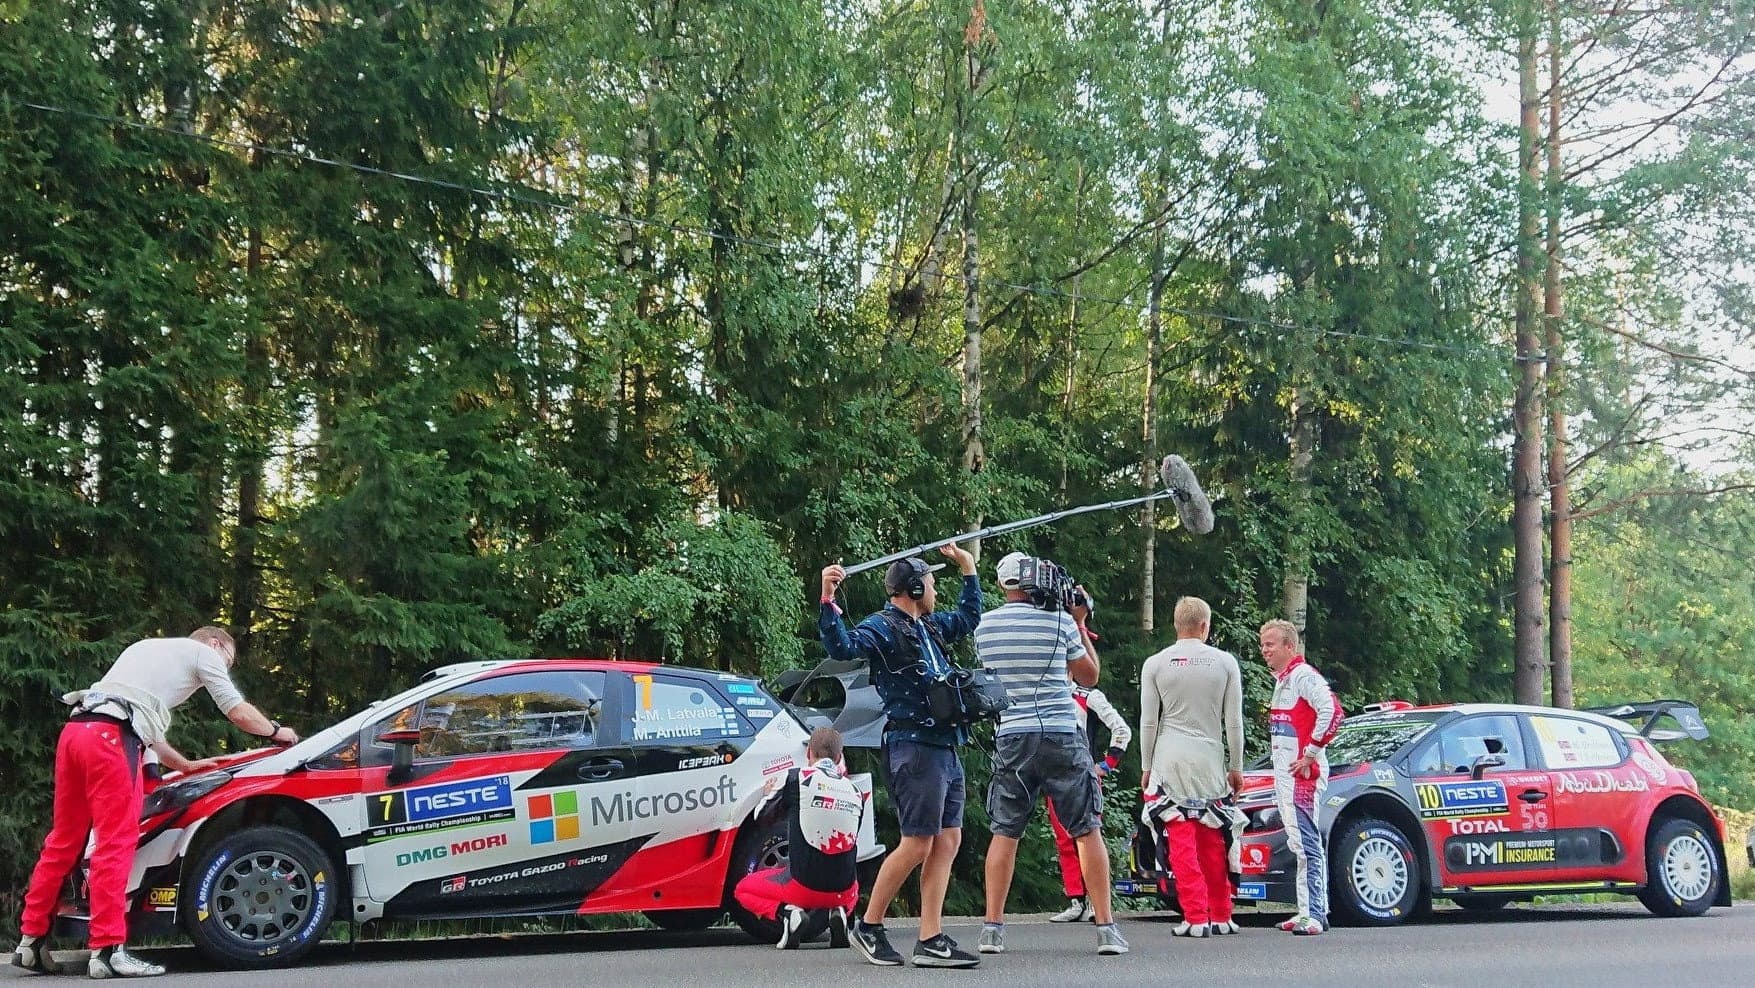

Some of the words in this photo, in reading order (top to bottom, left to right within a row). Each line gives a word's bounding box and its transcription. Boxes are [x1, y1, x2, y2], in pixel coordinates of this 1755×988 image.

[632, 675, 653, 711] 7
[667, 707, 718, 721] Latvala
[633, 727, 652, 740] M.
[656, 724, 701, 739] Anttila
[379, 794, 393, 821] 7
[414, 785, 499, 813] NESTE
[591, 774, 738, 826] Microsoft
[811, 799, 834, 809] GR
[1418, 784, 1440, 808] 10
[1445, 786, 1498, 801] NESTE
[395, 824, 406, 834] FIA
[407, 822, 424, 833] World
[425, 820, 441, 831] Rally
[441, 815, 482, 829] Championship
[1446, 819, 1510, 835] TOTAL
[396, 846, 448, 867] DMG
[451, 833, 507, 856] MORI
[1465, 841, 1504, 865] PMI
[1505, 848, 1556, 864] INSURANCE
[199, 853, 227, 904] MICHELIN
[468, 871, 520, 888] TOYOTA
[521, 861, 566, 877] GAZOO
[567, 853, 608, 867] Racing
[150, 889, 177, 903] OMP
[302, 890, 326, 939] MICHELIN
